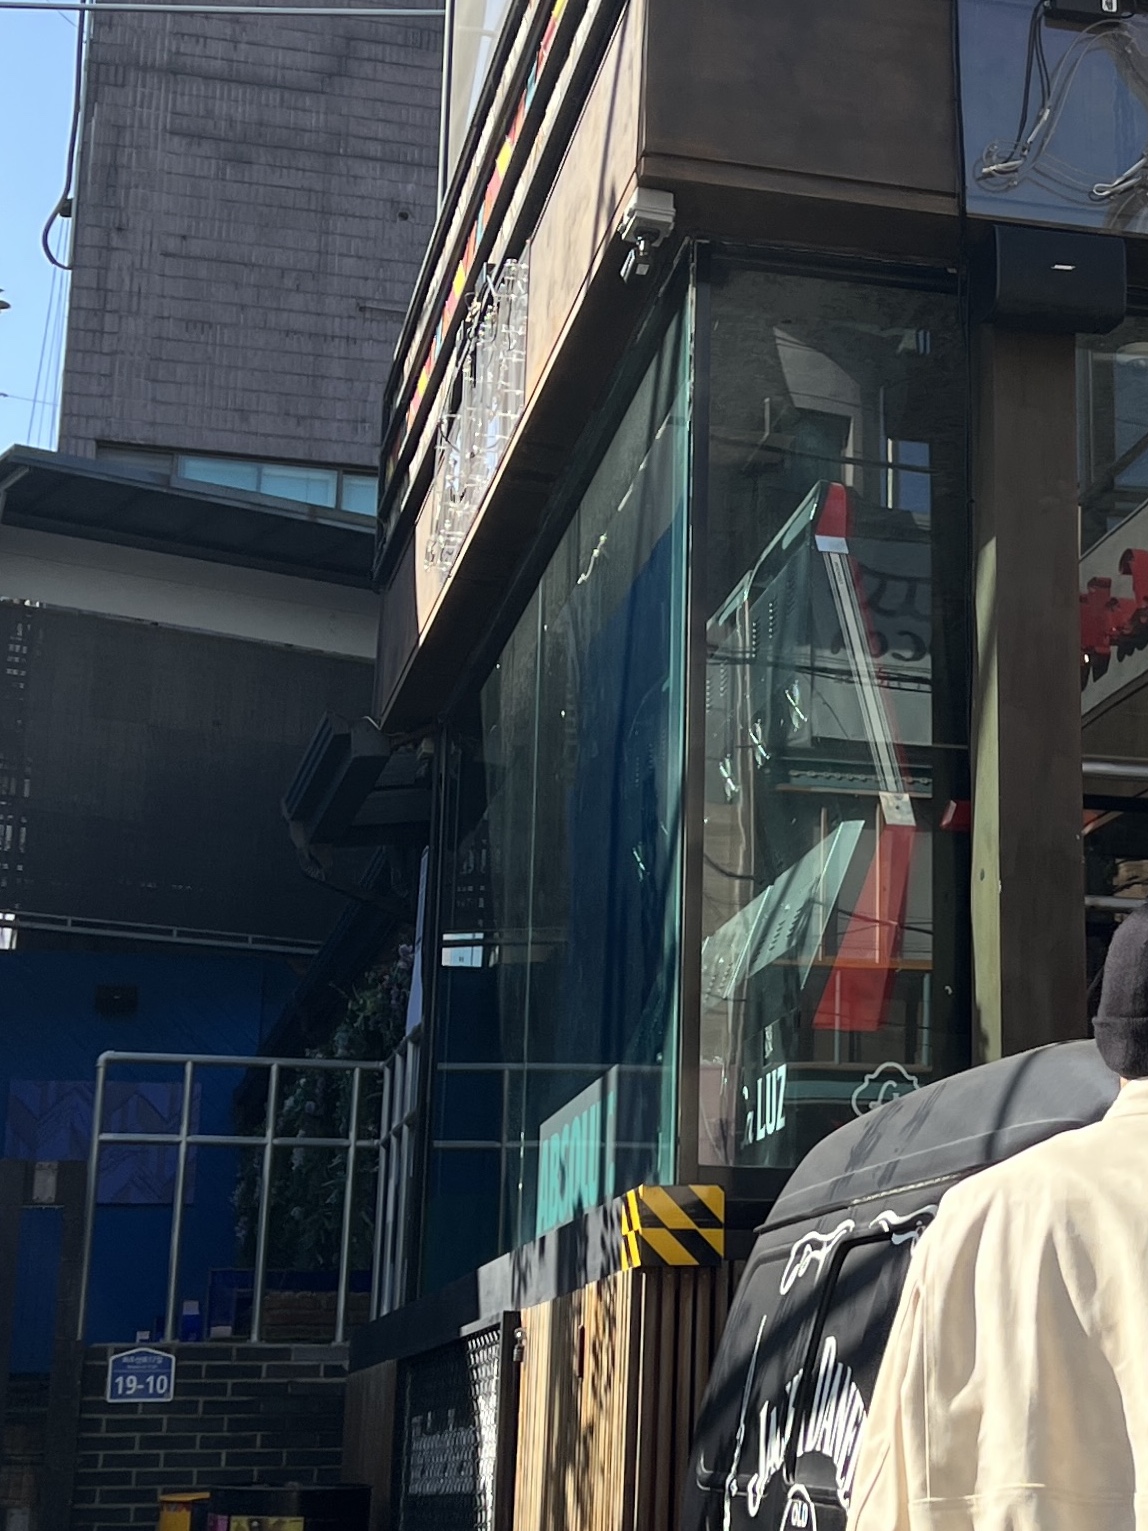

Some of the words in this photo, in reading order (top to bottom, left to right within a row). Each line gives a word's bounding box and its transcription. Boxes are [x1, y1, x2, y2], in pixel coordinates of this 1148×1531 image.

[756, 1063, 787, 1141] LUZ
[114, 1375, 168, 1395] 19-10
[790, 1501, 809, 1528] OLD
